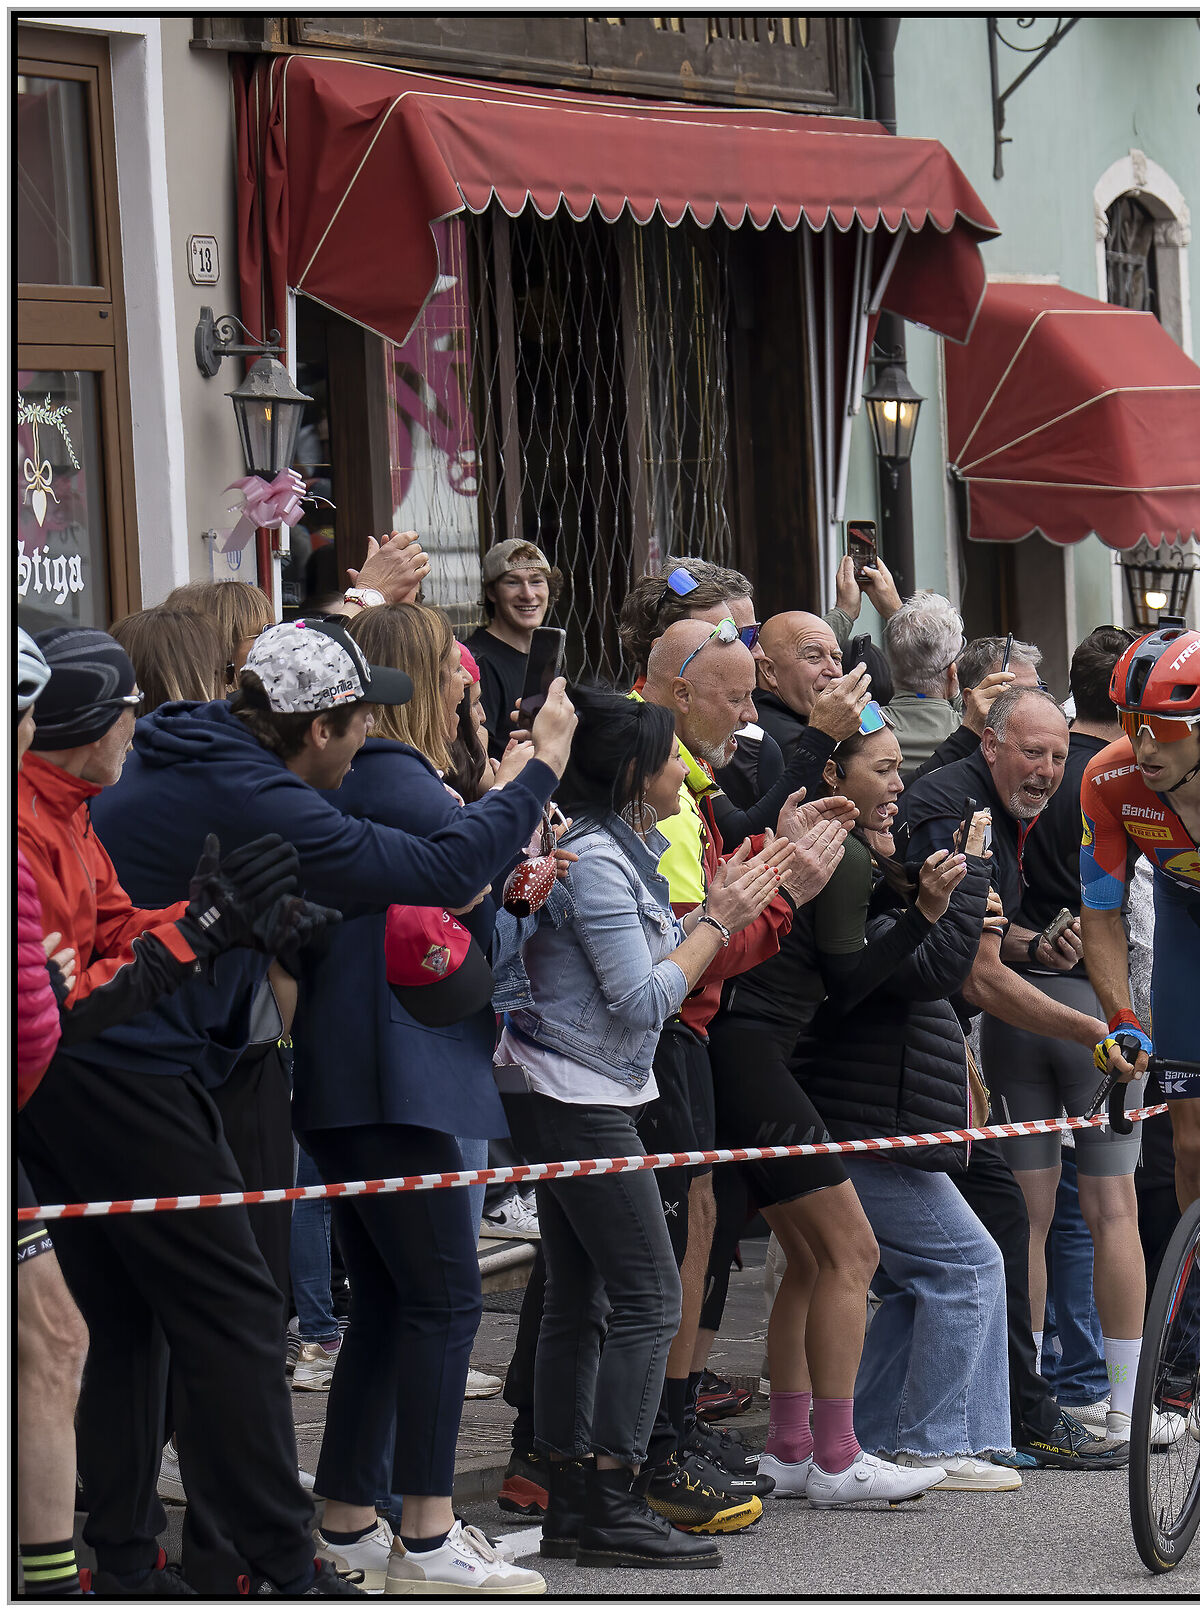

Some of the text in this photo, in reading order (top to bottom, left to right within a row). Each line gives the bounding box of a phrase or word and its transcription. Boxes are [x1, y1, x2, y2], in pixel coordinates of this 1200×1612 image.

[199, 247, 212, 273] 13
[322, 679, 353, 702] aprilia
[1121, 803, 1165, 822] Santini
